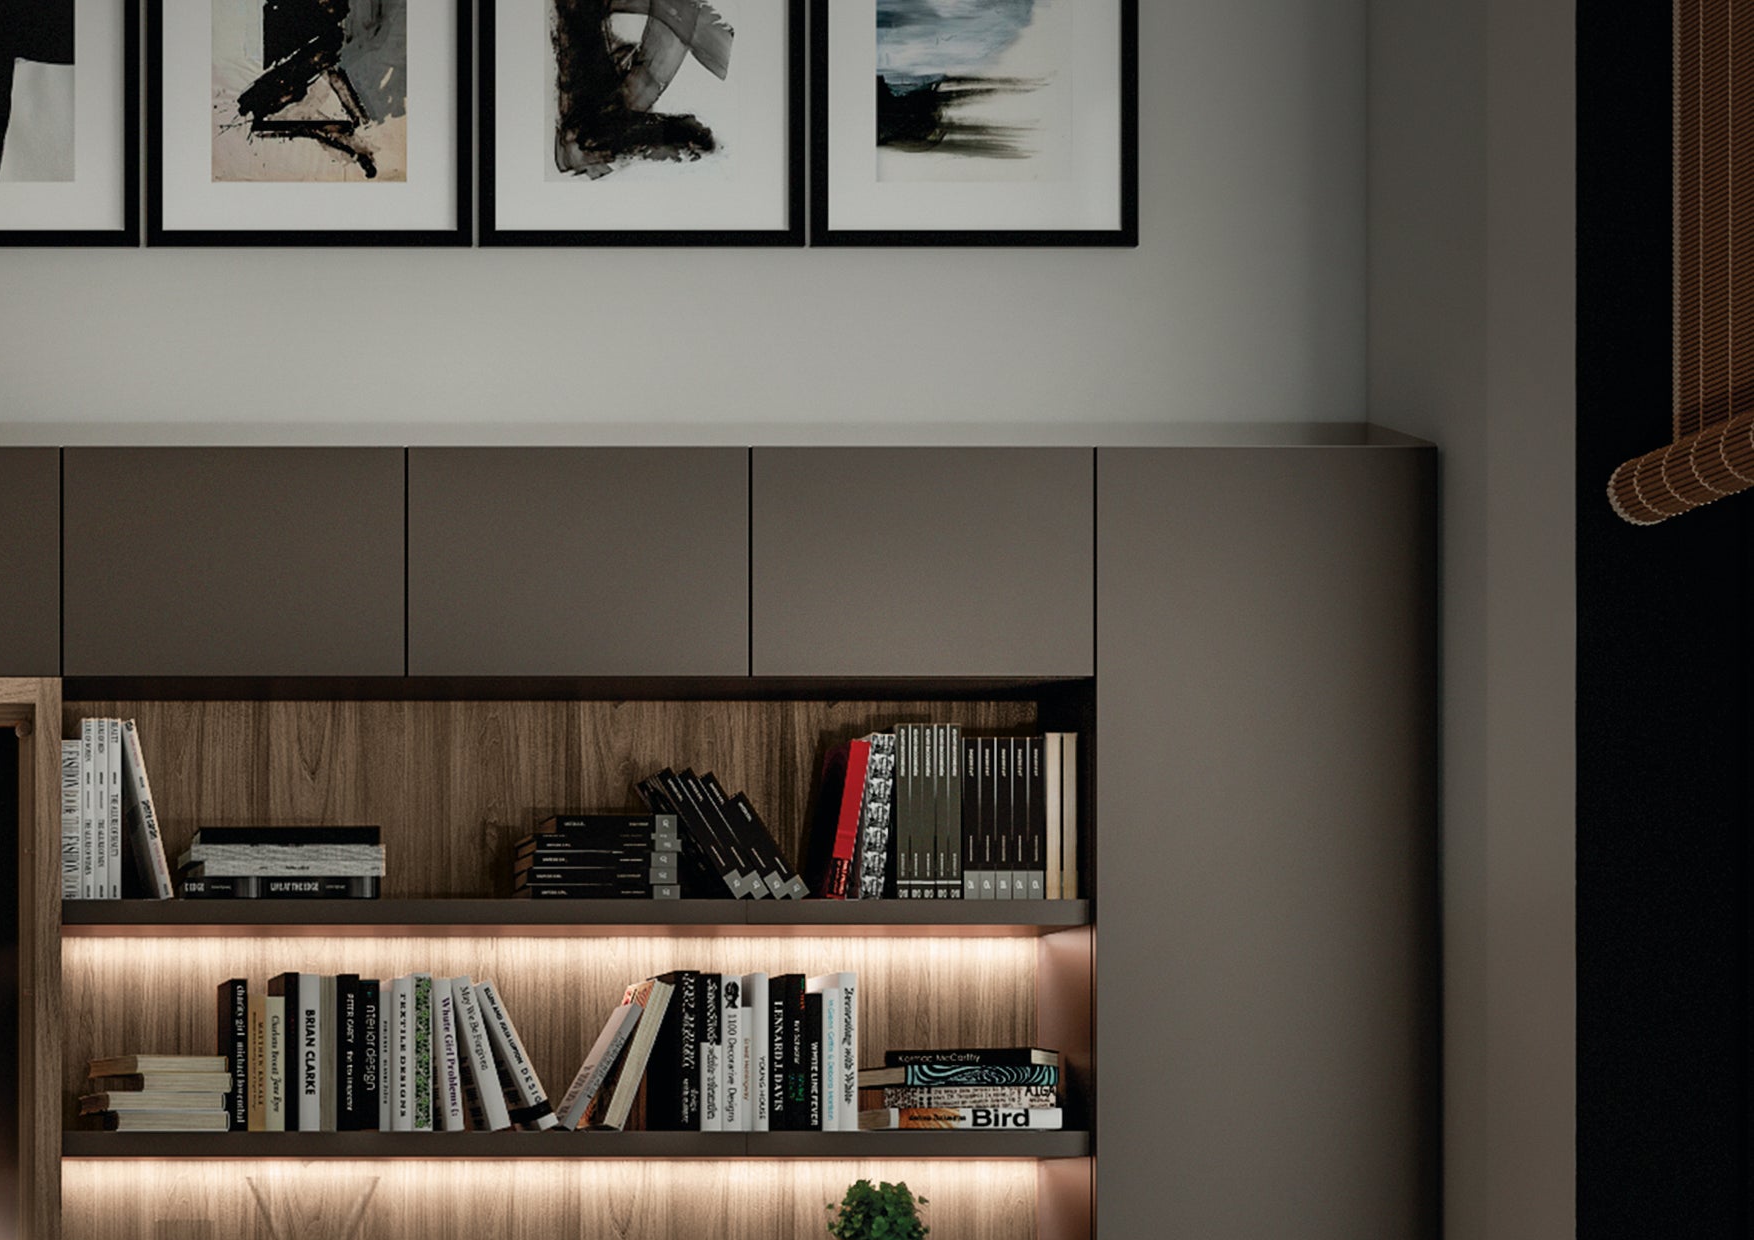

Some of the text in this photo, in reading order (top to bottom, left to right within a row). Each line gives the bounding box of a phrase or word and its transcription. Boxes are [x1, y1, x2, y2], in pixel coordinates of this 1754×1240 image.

[234, 1019, 246, 1036] girl
[305, 1009, 316, 1095] BRIAN CLARKE
[445, 1034, 455, 1056] Girl
[460, 986, 488, 1071] May We Be Forgiven
[484, 987, 496, 1005] ELLEN
[492, 1006, 502, 1020] AND
[507, 1039, 523, 1064] LUPTON
[521, 1068, 542, 1105] DESIG
[774, 1001, 784, 1060] LENNARD
[447, 1059, 459, 1107] Problems
[726, 1014, 737, 1123] 1100 Decorative Designs
[774, 1074, 784, 1111] DAVIS
[810, 1041, 819, 1127] WHITE LINE FEVER
[1025, 1086, 1056, 1097] AIGA
[972, 1108, 1030, 1127] Bird
